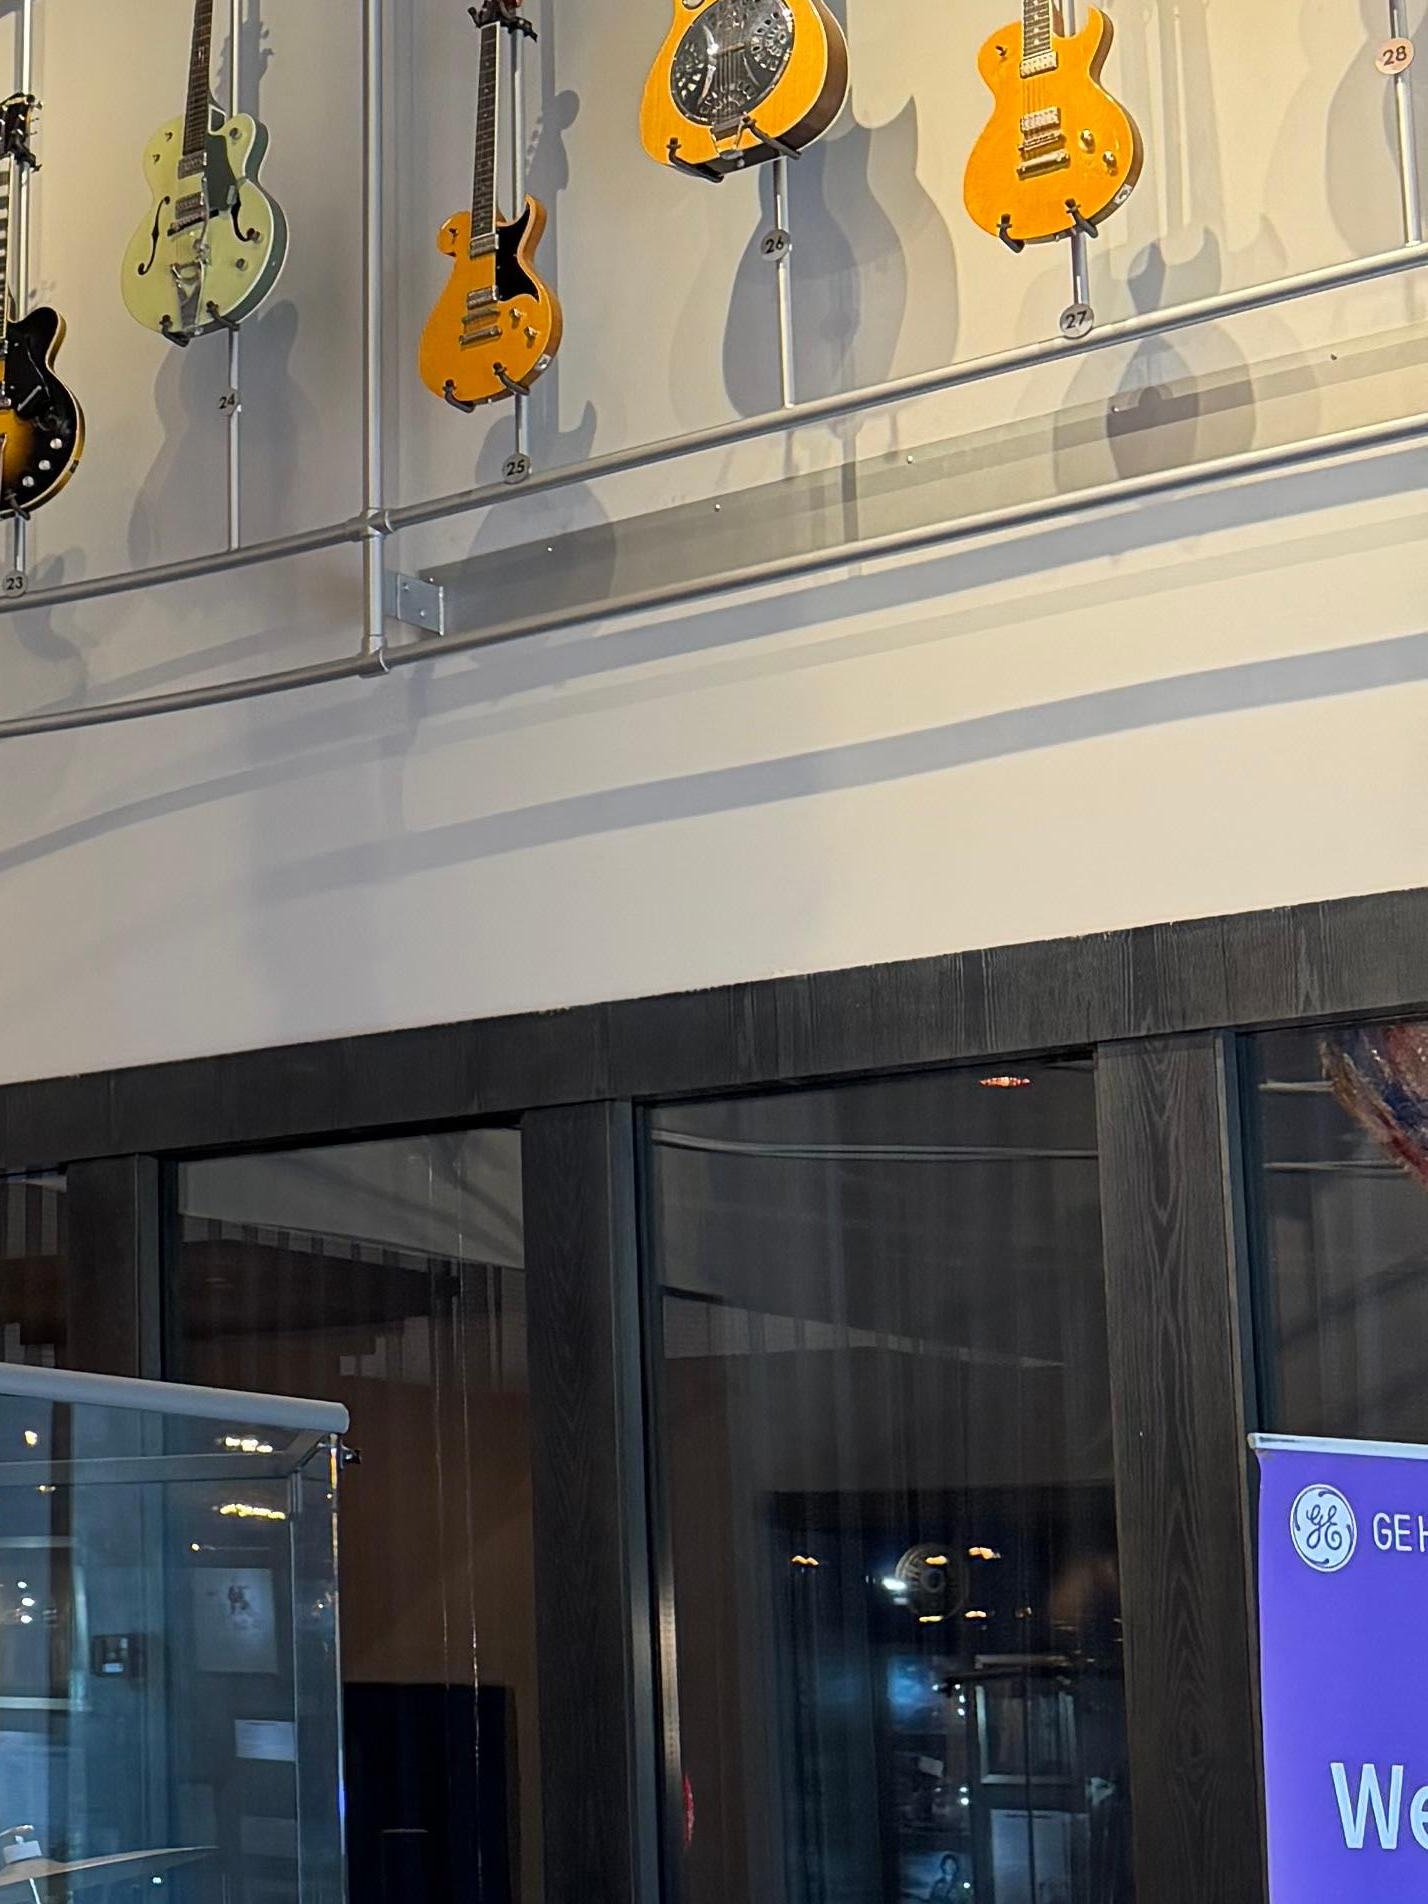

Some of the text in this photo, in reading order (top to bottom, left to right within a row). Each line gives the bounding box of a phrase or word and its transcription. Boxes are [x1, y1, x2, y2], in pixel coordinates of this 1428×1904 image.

[1382, 45, 1407, 67] 28
[765, 235, 784, 255] 26
[1065, 310, 1087, 329] 27
[218, 392, 236, 409] 24
[506, 459, 525, 476] 25
[5, 576, 23, 591] 23
